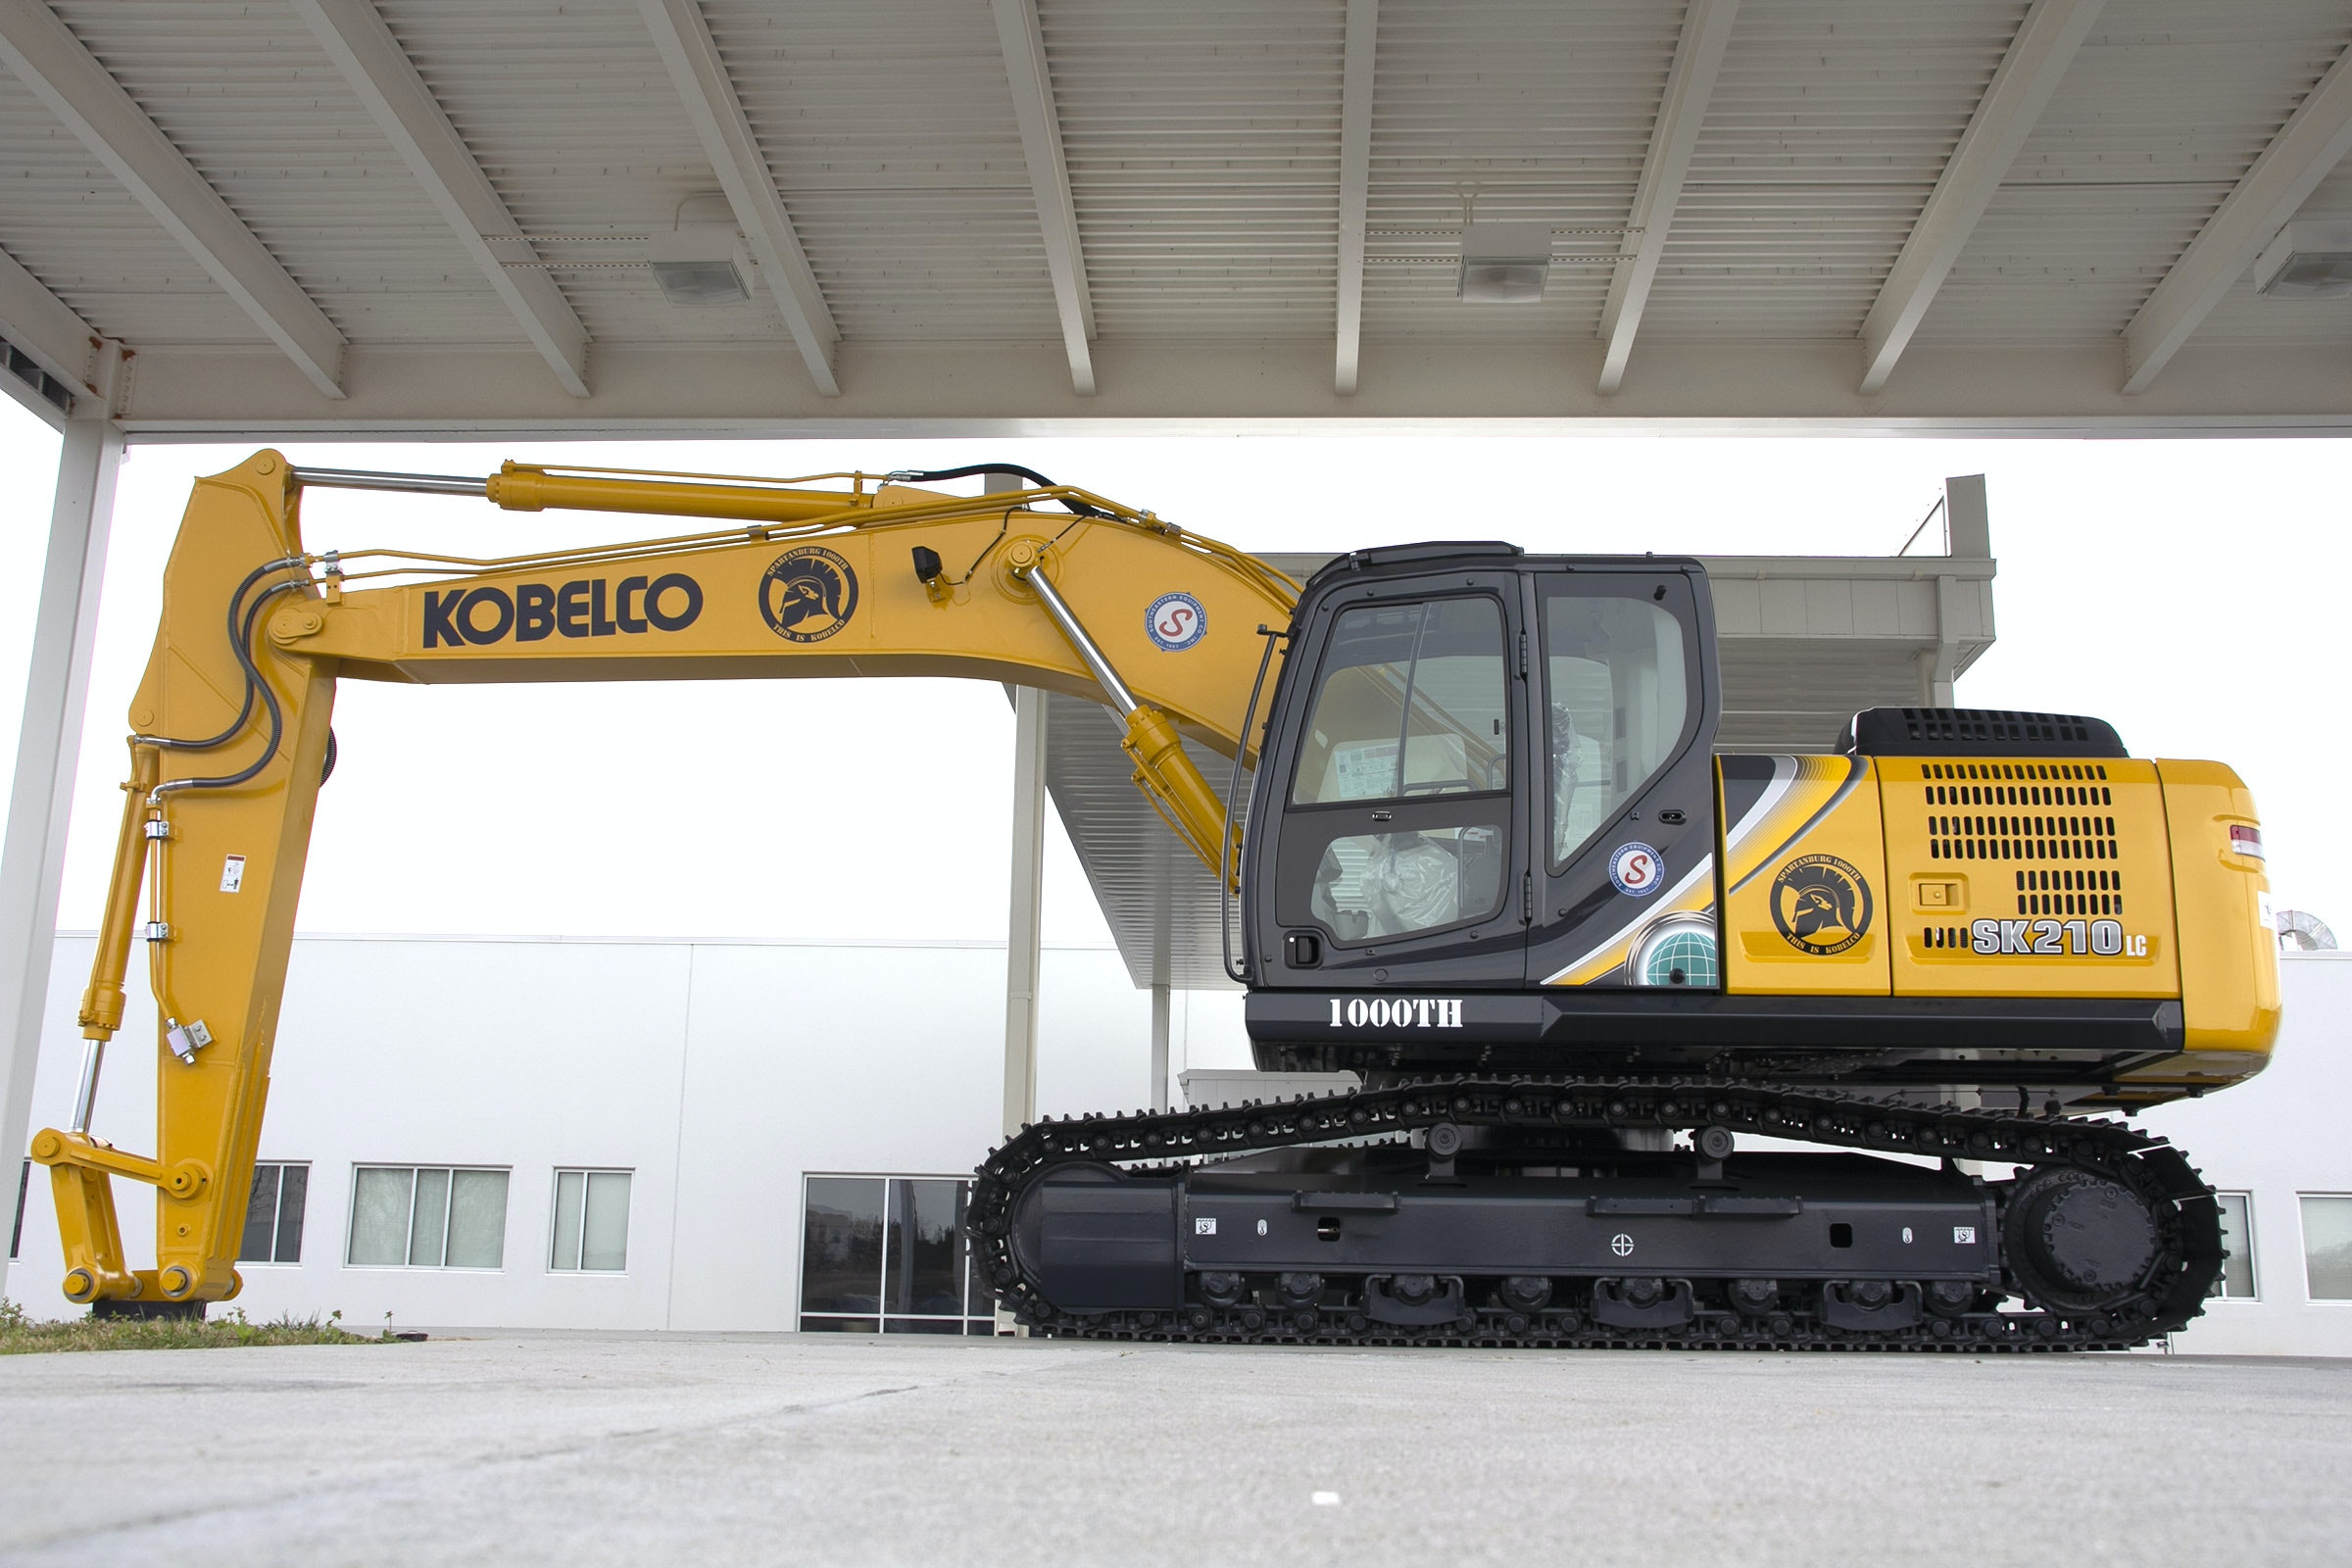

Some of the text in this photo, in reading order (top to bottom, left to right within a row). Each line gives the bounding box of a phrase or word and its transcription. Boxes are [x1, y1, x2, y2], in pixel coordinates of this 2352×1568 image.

[766, 547, 849, 576] SPARTANBURG 1000TH
[422, 572, 704, 649] KOBELCO
[1148, 595, 1177, 632] SOUTHEASTERN
[1179, 595, 1204, 622] EQUIPMENT
[773, 622, 792, 639] THIS
[810, 618, 846, 642] KOBELCO
[1777, 855, 1862, 883] SPARTANBURG 1000TH
[1787, 932, 1861, 955] THIS IS KOBELCO
[1972, 918, 2147, 956] SK210 LC
[1329, 998, 1463, 1028] 1000TH
